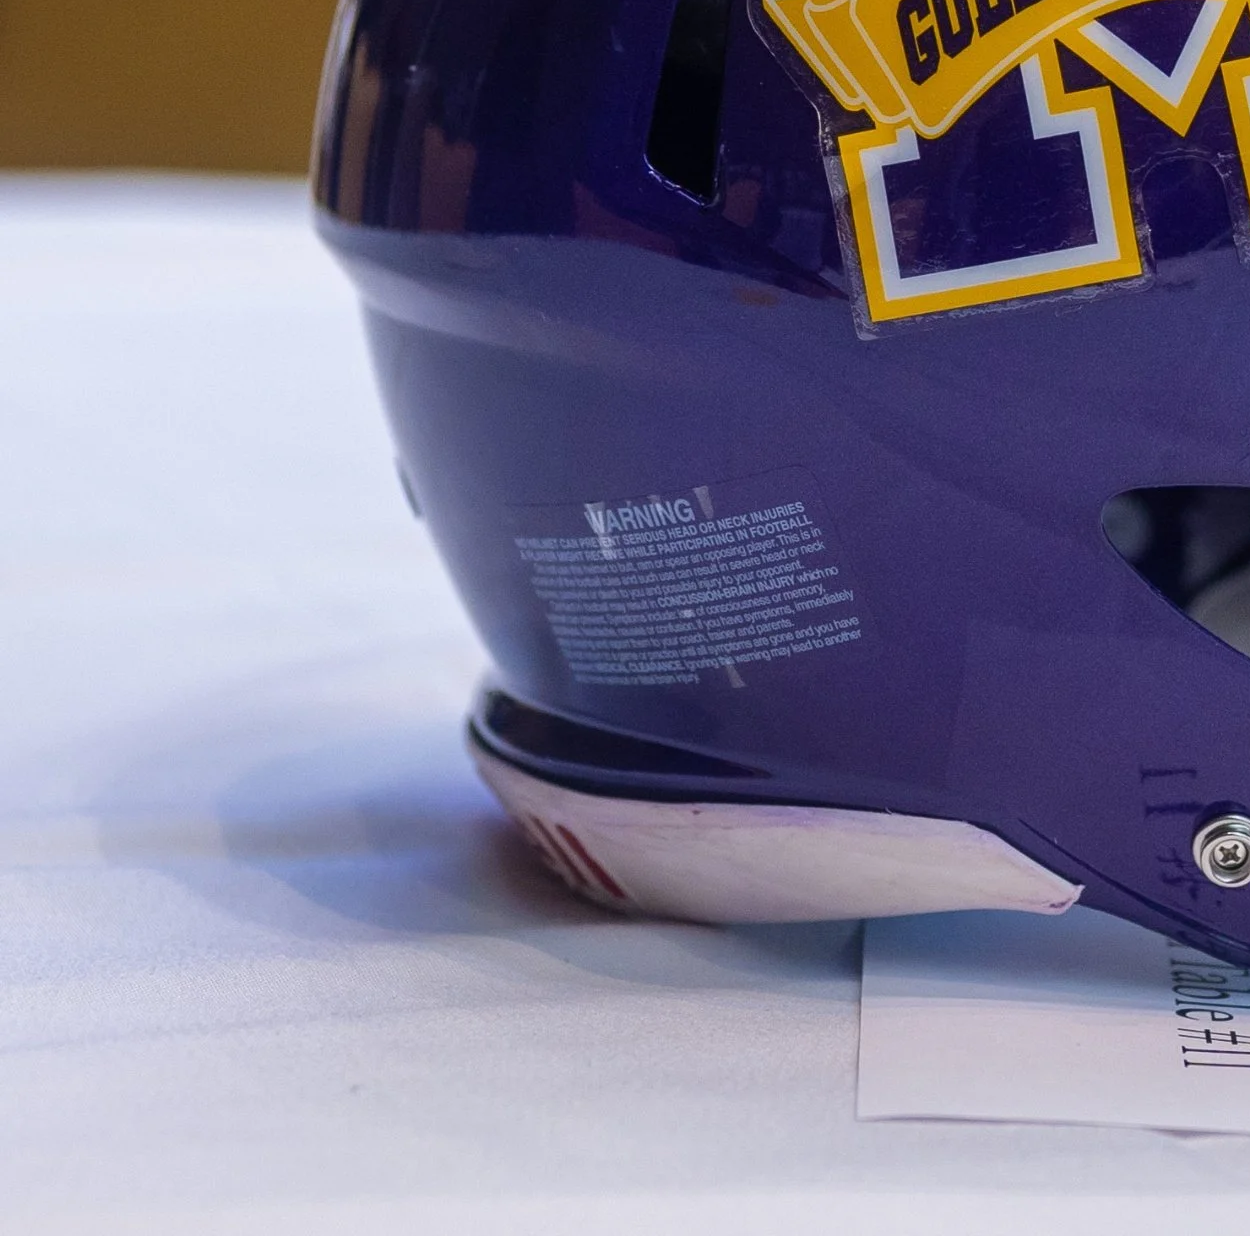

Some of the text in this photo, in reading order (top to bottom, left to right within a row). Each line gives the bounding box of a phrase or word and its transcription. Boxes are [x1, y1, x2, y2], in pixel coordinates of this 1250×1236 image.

[584, 499, 694, 532] WARNING
[622, 530, 665, 544] SERIOUS
[667, 525, 696, 538] HEAD
[698, 521, 716, 533] OR
[717, 514, 749, 529] NECK
[751, 502, 804, 522] INJURIES
[624, 545, 656, 558] WHILE
[657, 532, 734, 554] PARTICIPATING
[735, 529, 748, 540] IN
[749, 514, 813, 537] FOOTBALL
[664, 556, 690, 568] spear
[690, 553, 703, 562] an
[703, 544, 746, 562] opposing
[746, 537, 778, 554] player.
[776, 532, 799, 545] This
[800, 529, 810, 540] is
[811, 527, 821, 537] in
[658, 571, 675, 580] use
[675, 568, 692, 578] can
[692, 563, 718, 575] result
[719, 561, 728, 571] in
[729, 555, 761, 569] severe
[761, 548, 786, 562] head
[788, 547, 798, 556] or
[800, 540, 825, 553] neck
[661, 580, 697, 596] possible
[697, 576, 722, 590] injury
[722, 573, 733, 584] to
[733, 571, 754, 584] your
[755, 558, 804, 579] opponent.
[657, 583, 755, 607] CONCUSSION-BRAIN
[755, 574, 794, 591] INJURY
[795, 567, 825, 582] which
[825, 566, 839, 575] no
[695, 606, 705, 616] of
[705, 593, 770, 614] consciousness
[771, 592, 782, 602] or
[782, 583, 825, 601] memory,
[705, 618, 721, 630] you
[720, 612, 743, 625] have
[743, 601, 794, 623] symptoms,
[794, 589, 853, 612] immediately
[707, 627, 736, 641] trainer
[736, 624, 755, 636] and
[756, 616, 794, 634] parents.
[708, 638, 753, 656] symptoms
[753, 636, 769, 646] are
[770, 631, 794, 645] gone
[794, 625, 814, 637] and
[814, 622, 833, 635] you
[833, 615, 858, 628] have
[734, 648, 770, 664] warning
[770, 645, 791, 658] may
[790, 639, 812, 651] lead
[812, 636, 824, 647] to
[824, 629, 862, 644] another
